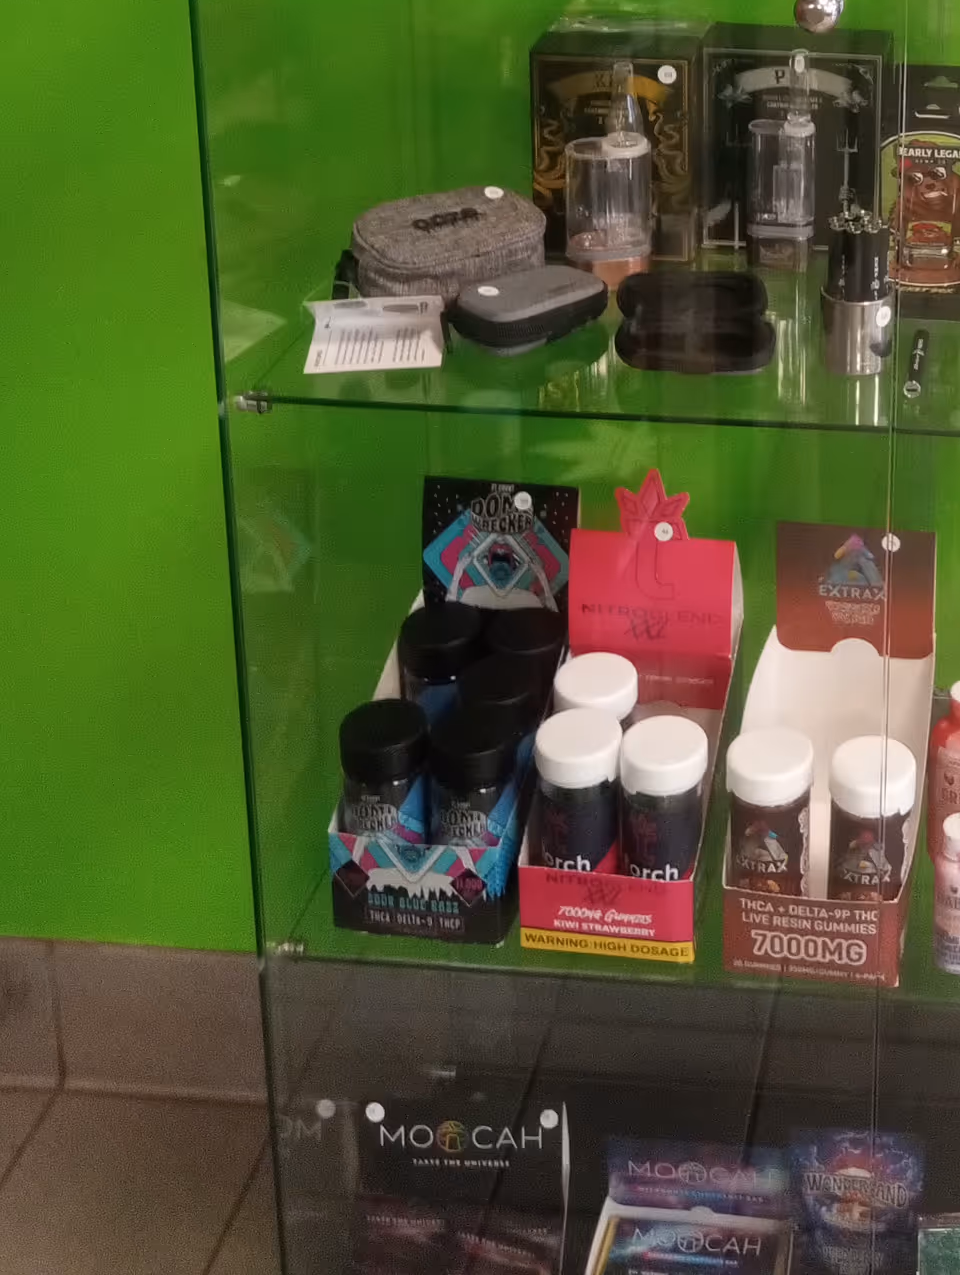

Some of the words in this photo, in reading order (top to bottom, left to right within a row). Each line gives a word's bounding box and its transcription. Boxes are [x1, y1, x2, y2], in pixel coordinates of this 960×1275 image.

[471, 492, 533, 518] DOM
[818, 584, 887, 601] EXTRAX
[544, 852, 591, 873] orch
[629, 863, 679, 882] orch
[740, 898, 774, 914] THCA
[854, 909, 879, 922] THC
[554, 919, 579, 929] KIWI
[582, 922, 656, 937] STRAWBERRY
[742, 911, 770, 925] LIVE
[773, 913, 812, 930] RESIN
[814, 920, 878, 936] GUMMIES
[593, 939, 628, 952] HIGH
[630, 944, 690, 958] DOSAGE
[751, 928, 868, 966] 7000MG
[412, 1158, 440, 1167] TASTE
[444, 1158, 461, 1167] THE
[464, 1159, 510, 1168] UNIVERSE
